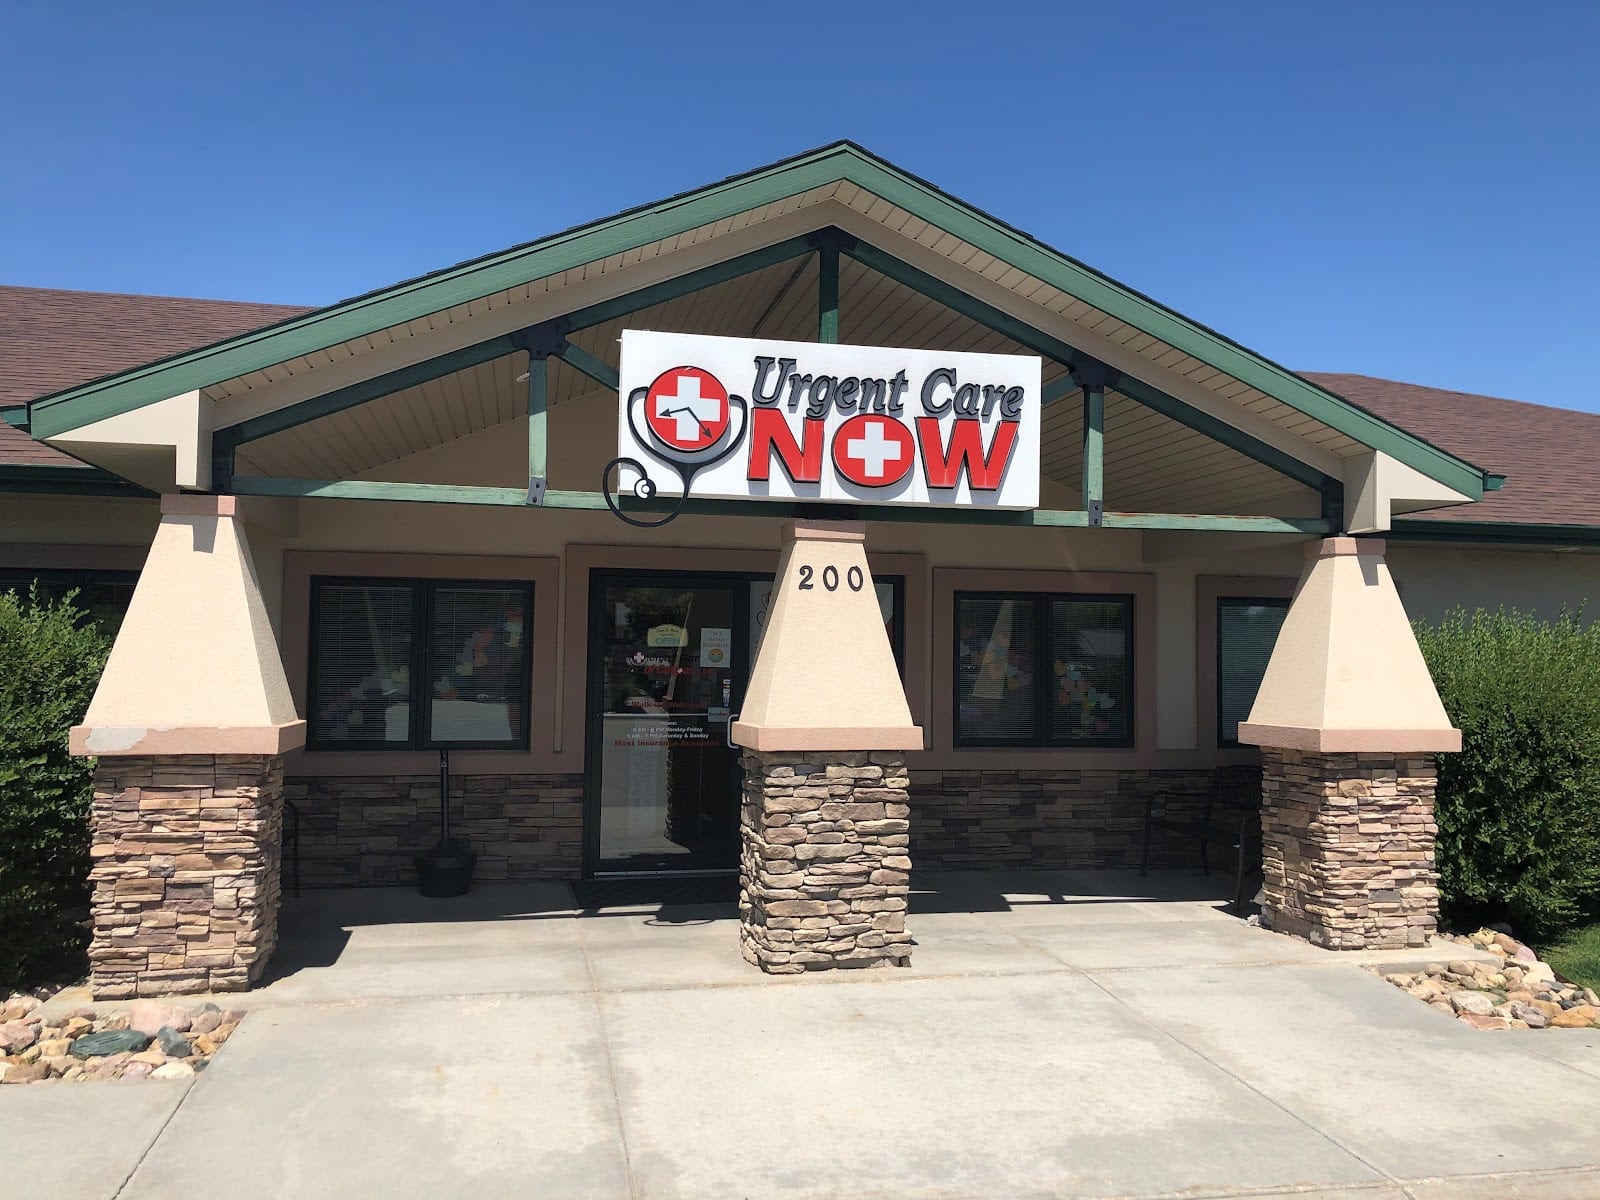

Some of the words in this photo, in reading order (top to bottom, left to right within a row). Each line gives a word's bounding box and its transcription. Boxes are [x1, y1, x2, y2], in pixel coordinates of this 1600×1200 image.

[752, 356, 908, 420] Urgent
[920, 367, 1025, 418] Care
[747, 407, 1020, 490] NOW
[799, 565, 864, 592] 200
[655, 637, 680, 645] OPEN
